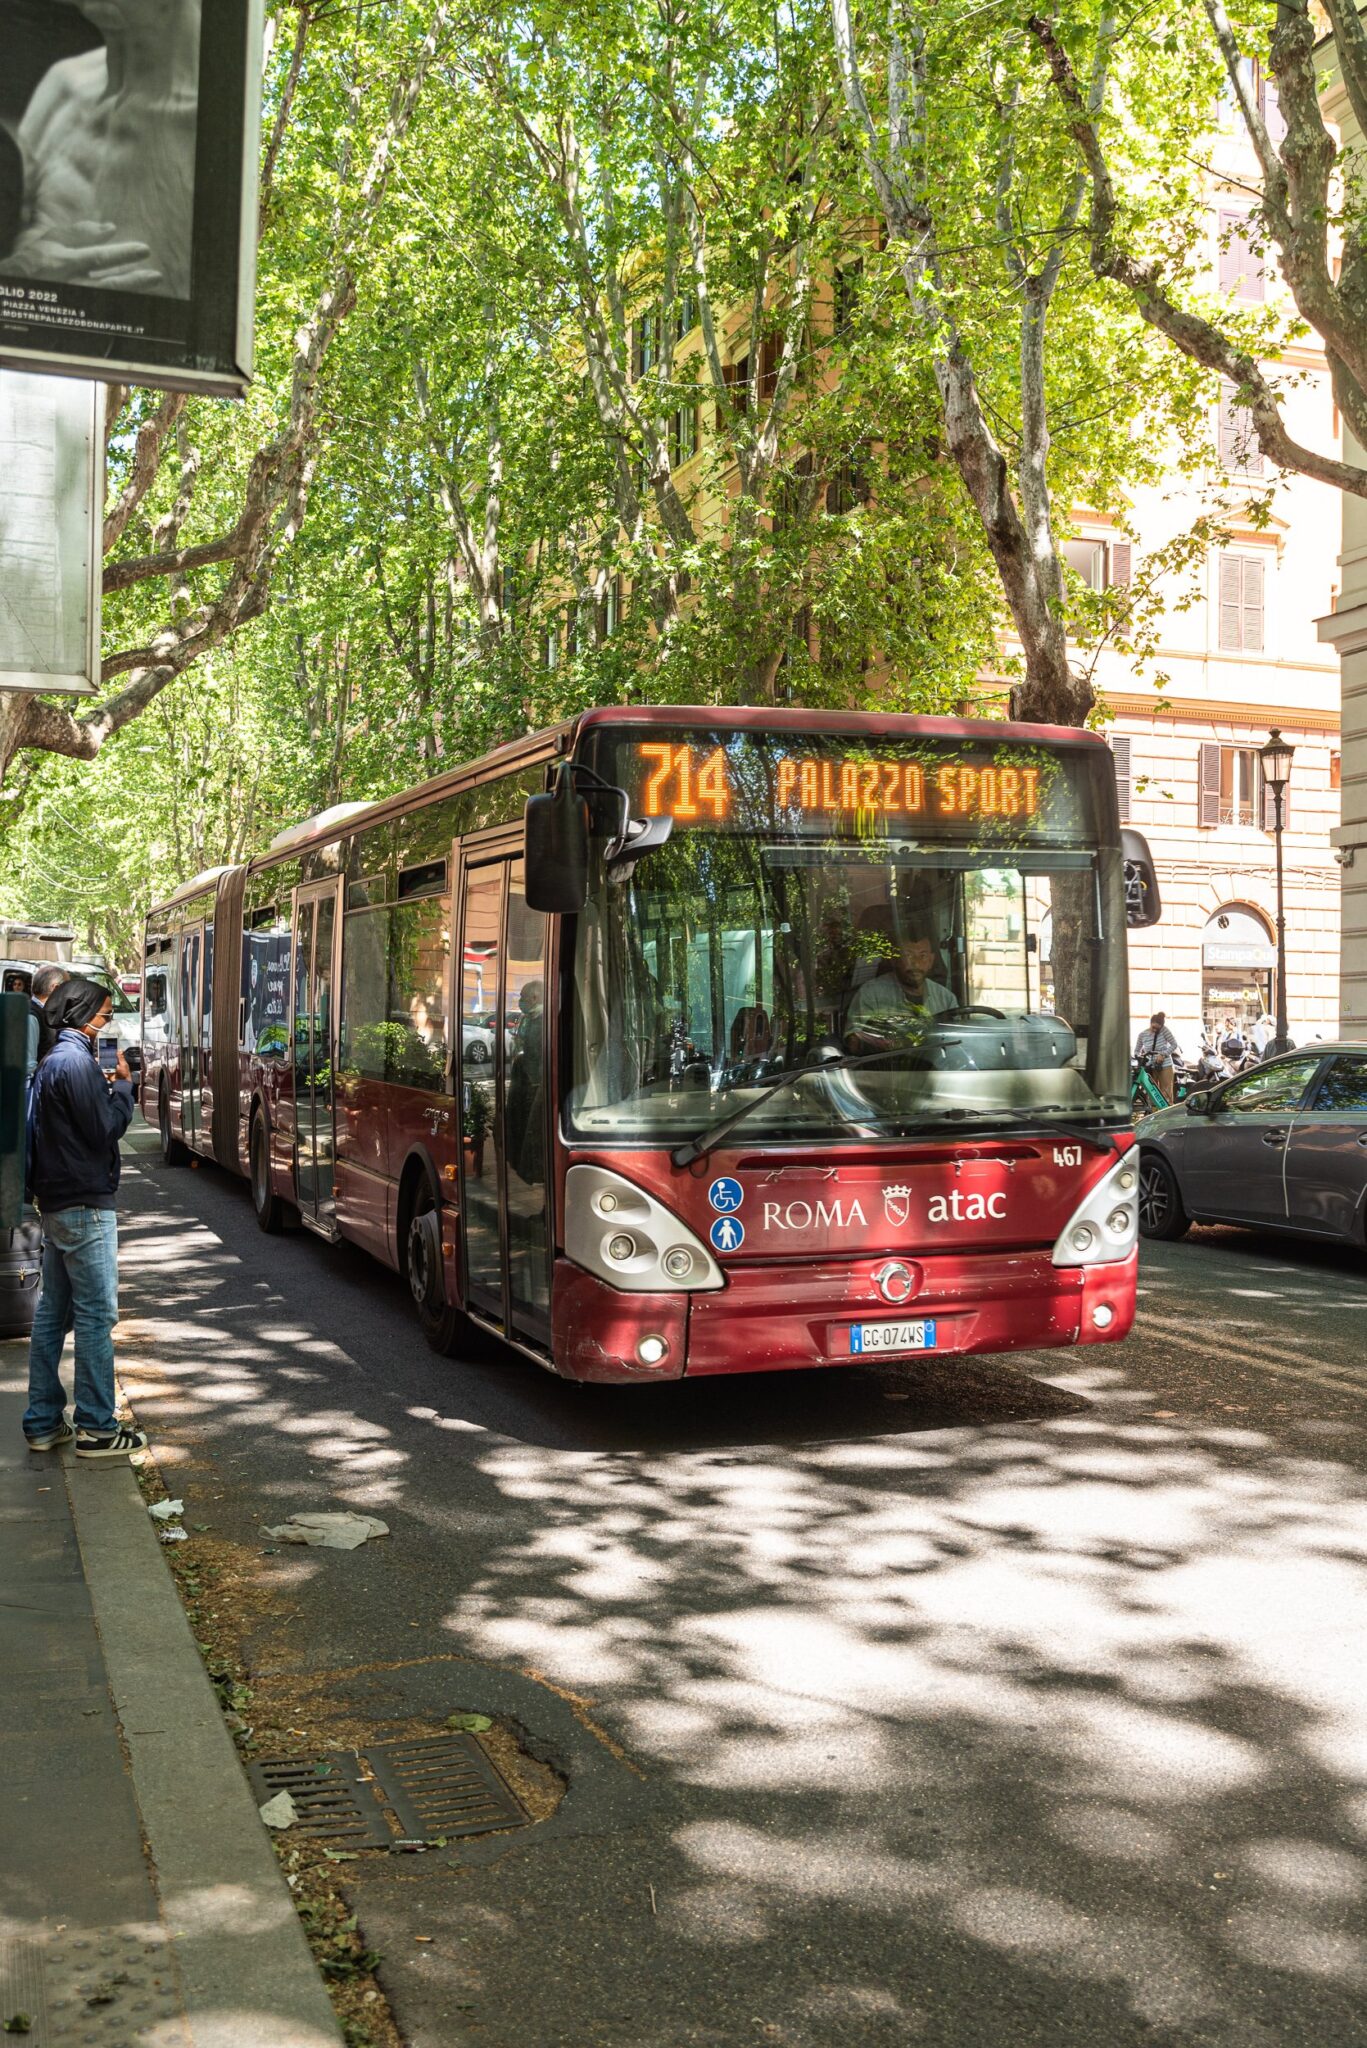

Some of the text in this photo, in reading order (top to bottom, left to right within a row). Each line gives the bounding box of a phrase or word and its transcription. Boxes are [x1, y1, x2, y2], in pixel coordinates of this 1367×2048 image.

[2, 299, 36, 311] PIAZZA
[38, 304, 77, 317] VENEZIA
[28, 289, 58, 303] 2022
[641, 745, 1038, 815] 714 PALAZZO SPORT
[1052, 1145, 1082, 1167] 467
[763, 1199, 869, 1230] ROMA
[927, 1189, 1007, 1222] atac
